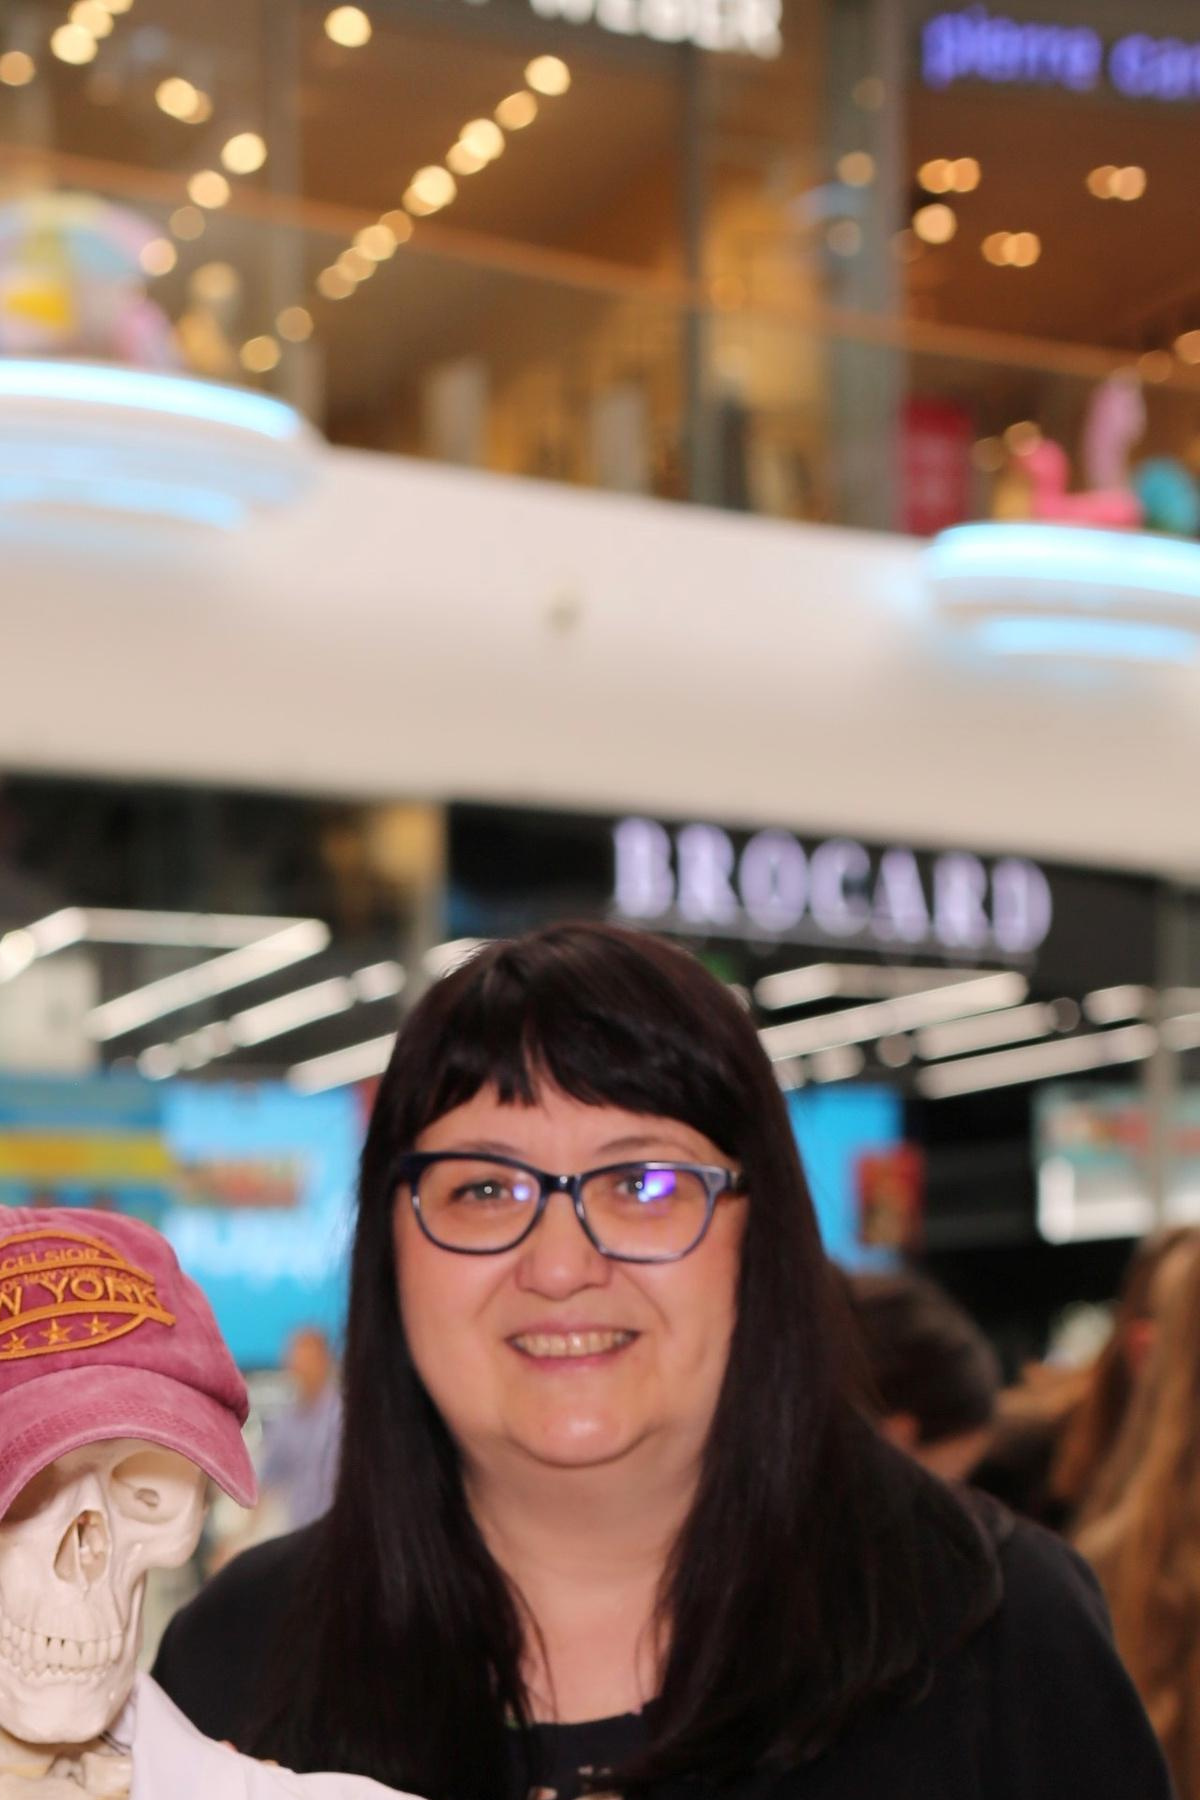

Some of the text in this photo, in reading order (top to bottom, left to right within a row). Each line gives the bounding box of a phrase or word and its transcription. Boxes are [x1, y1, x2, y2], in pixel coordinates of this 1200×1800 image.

[923, 5, 1100, 90] pierre
[613, 817, 1052, 953] BROCARD
[39, 1274, 166, 1312] YORK
